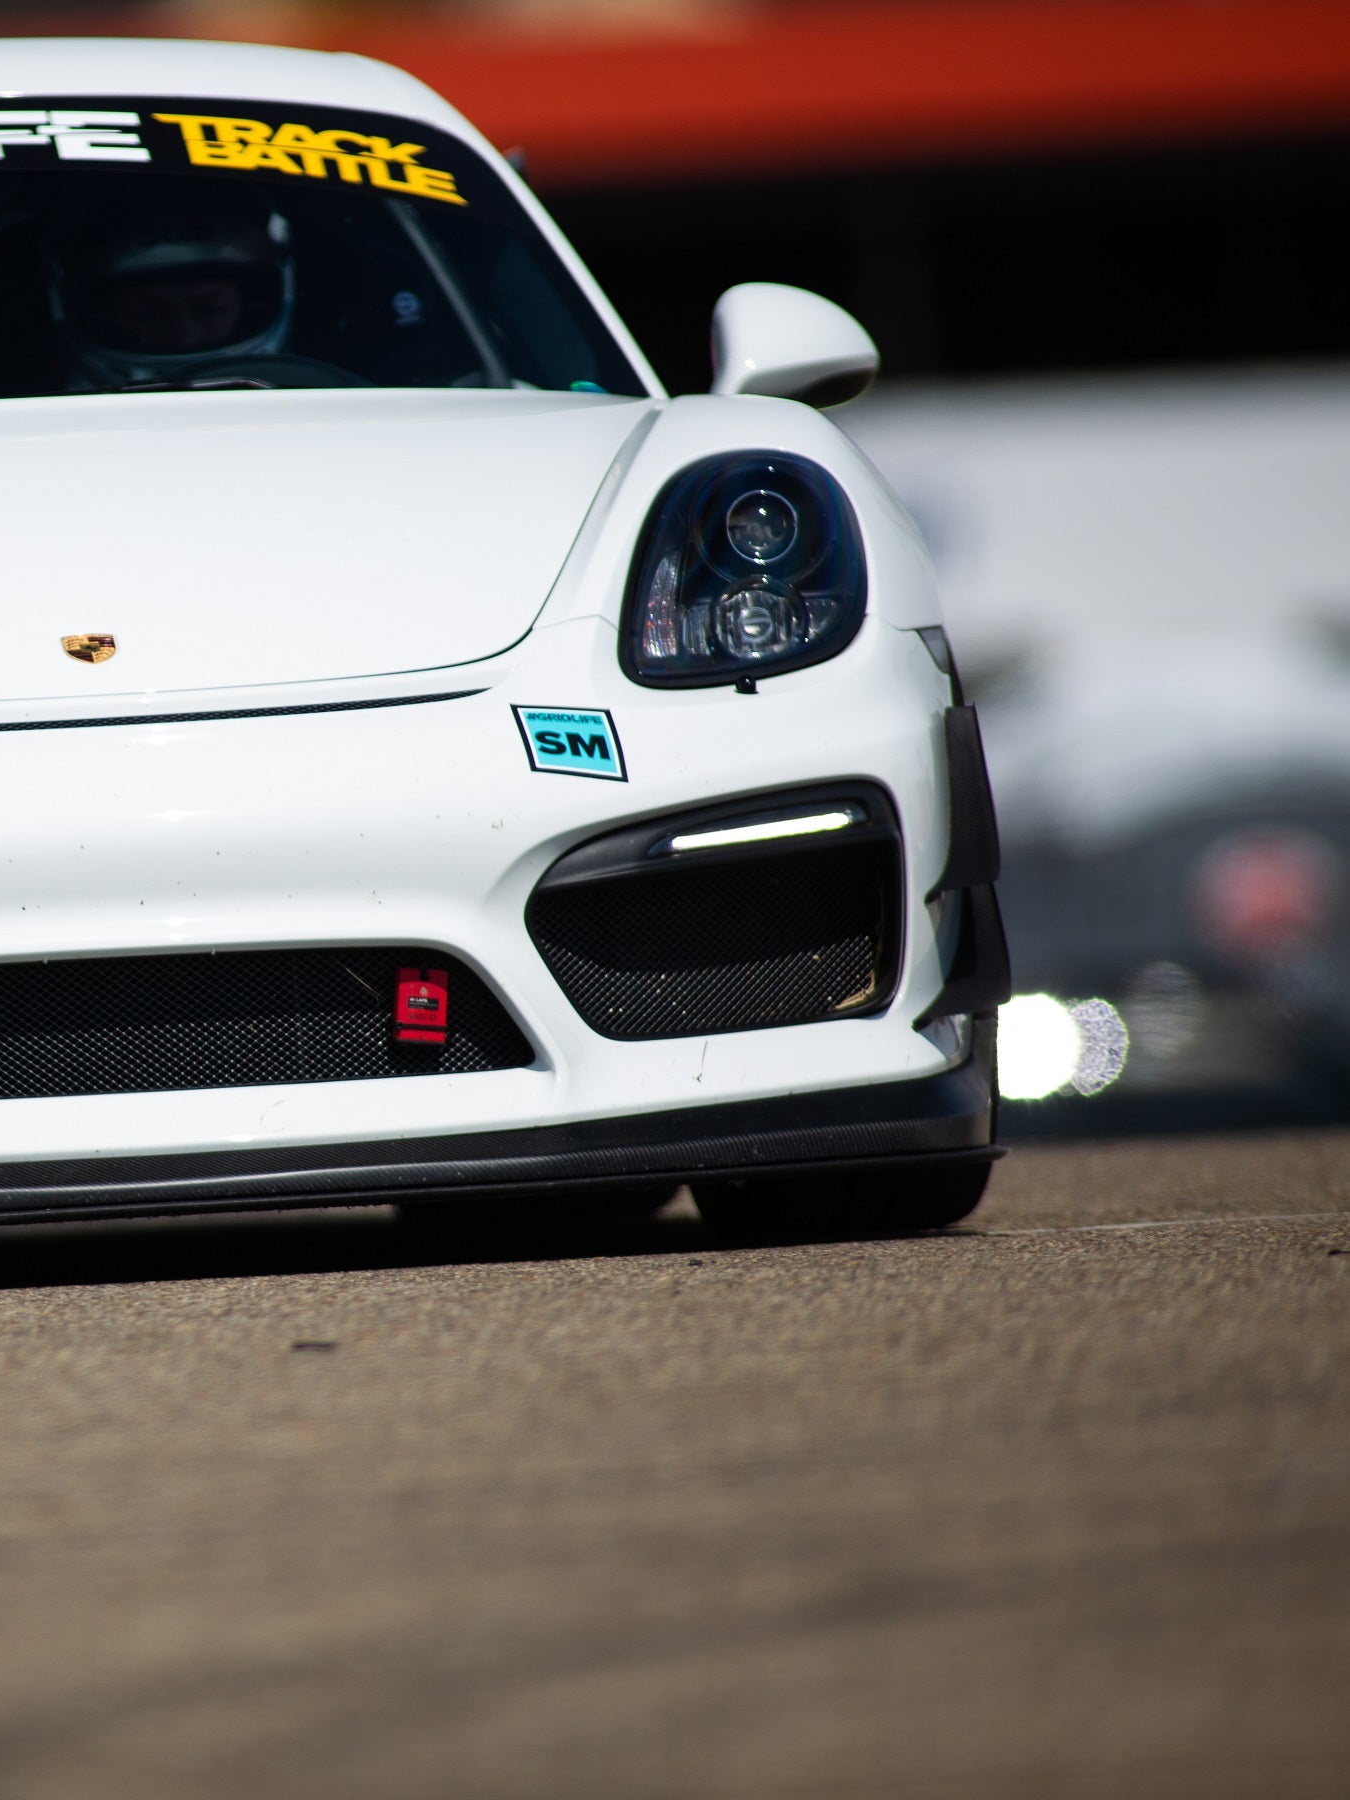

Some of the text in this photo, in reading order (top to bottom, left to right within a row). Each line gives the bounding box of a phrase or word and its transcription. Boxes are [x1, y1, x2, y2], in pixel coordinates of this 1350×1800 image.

[151, 113, 427, 165] TRACK
[186, 139, 469, 206] BATTLE
[535, 730, 611, 760] SM
